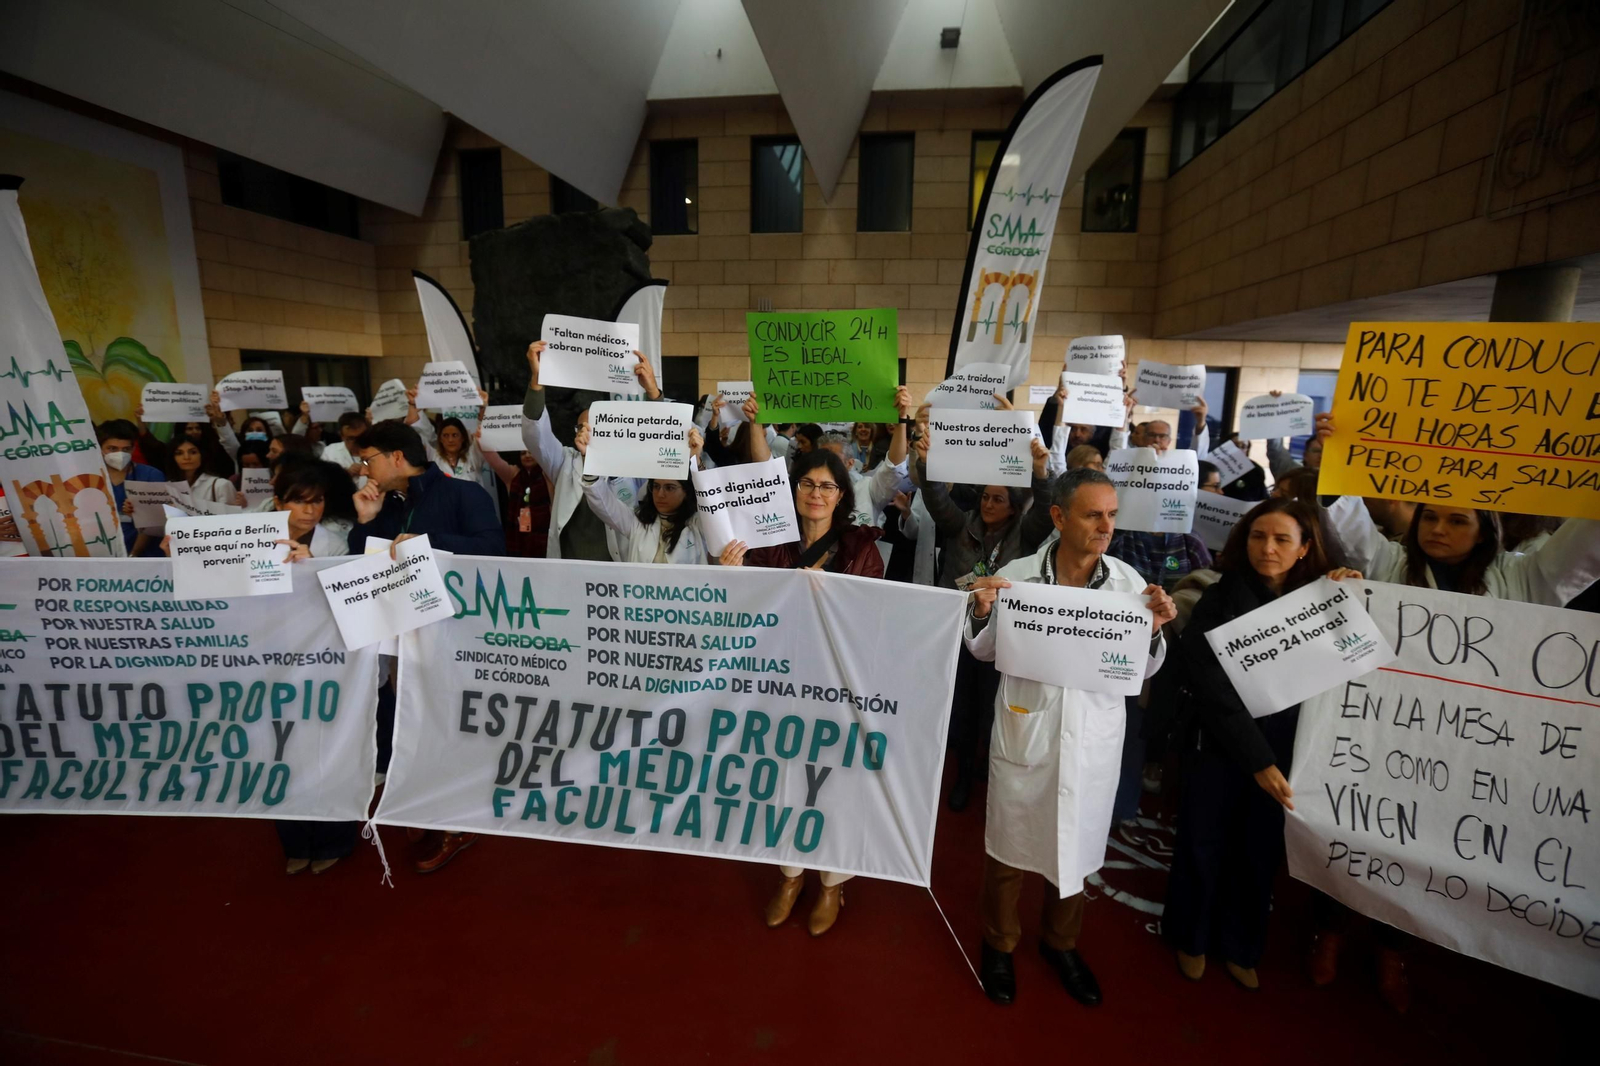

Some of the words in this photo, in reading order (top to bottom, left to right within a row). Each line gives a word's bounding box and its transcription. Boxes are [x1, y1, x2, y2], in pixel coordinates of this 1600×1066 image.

[987, 212, 1045, 244] SMA
[987, 242, 1040, 256] CÓRDOBA
[549, 328, 584, 340] “Faltan
[587, 334, 629, 346] médicos,
[850, 316, 873, 340] 24
[549, 342, 582, 353] sobran
[585, 347, 630, 359] políticos”
[763, 346, 789, 362] ES
[1356, 331, 1424, 368] PARA
[609, 364, 630, 374] SMA
[768, 368, 851, 387] ATENDER
[1141, 369, 1167, 379] ¡Mónica
[968, 374, 1005, 384] traidora!
[957, 384, 968, 392] 24
[970, 386, 996, 396] horas!
[1349, 371, 1388, 402] NO
[1402, 378, 1441, 408] TE
[1451, 382, 1572, 416] DEJAN
[764, 392, 842, 410] PACIENTES
[595, 414, 634, 425] ¡Mónica
[637, 416, 682, 427] petarda,
[930, 421, 980, 432] “Nuestros
[983, 423, 1031, 434] derechos
[1357, 408, 1397, 439] 24
[1415, 417, 1519, 449] HORAS
[593, 428, 610, 437] haz
[614, 429, 623, 437] tú
[627, 429, 636, 438] la
[639, 431, 684, 441] guardia!
[966, 438, 976, 446] tu
[979, 438, 1014, 447] salud”
[4, 440, 97, 460] CÓRDOBA
[659, 447, 681, 457] SMA
[1000, 455, 1024, 465] SMA
[1346, 445, 1422, 473] PERO
[1438, 456, 1498, 480] PARA
[1137, 464, 1194, 476] quemado,
[725, 475, 785, 493] dignidad,
[1130, 478, 1196, 492] colapsado”
[1369, 473, 1452, 498] VIDAS
[1162, 499, 1185, 509] SMA
[1196, 501, 1229, 516] “Menos
[754, 513, 784, 524] SMA
[1200, 514, 1220, 524] más
[171, 530, 190, 539] “De
[193, 528, 231, 539] España
[245, 524, 279, 534] Berlín,
[177, 544, 211, 556] porque
[214, 541, 237, 552] aquí
[258, 538, 278, 549] hay
[203, 554, 251, 568] porvenir”
[251, 560, 279, 570] SMA
[326, 576, 370, 592] “Menos
[372, 554, 430, 578] explotación,
[38, 578, 72, 591] POR
[76, 576, 174, 593] FORMACIÓN
[344, 590, 369, 605] más
[371, 568, 421, 598] protección”
[585, 583, 619, 598] POR
[623, 584, 727, 603] FORMACIÓN
[410, 588, 435, 602] SMA
[444, 567, 570, 630] SMA
[35, 599, 69, 612] POR
[73, 599, 228, 612] RESPONSABILIDAD
[1001, 598, 1053, 615] “Menos
[1058, 606, 1148, 626] explotación,
[41, 618, 78, 631] POR
[83, 618, 157, 631] NUESTRA
[161, 617, 215, 630] SALUD
[587, 605, 619, 620] POR
[624, 606, 778, 628] RESPONSABILIDAD
[1225, 624, 1286, 658] ¡Mónica,
[1285, 588, 1348, 626] traidora!
[587, 627, 620, 642] POR
[625, 629, 697, 648] NUESTRA
[700, 635, 757, 651] SALUD
[1014, 620, 1042, 631] más
[1047, 625, 1131, 641] protección”
[45, 637, 82, 650] POR
[85, 636, 172, 650] NUESTRAS
[175, 634, 248, 648] FAMILIAS
[1240, 648, 1278, 672] ¡Stop
[1280, 634, 1301, 652] 24
[1300, 611, 1348, 641] horas!
[1333, 633, 1366, 653] SMA
[50, 656, 85, 669] POR
[90, 656, 112, 669] LA
[115, 655, 197, 668] DIGNIDAD
[201, 654, 218, 667] DE
[222, 655, 260, 667] UNA
[262, 648, 345, 666] PROFESIÓN
[455, 650, 518, 666] SINDICATO
[521, 654, 567, 671] MÉDICO
[587, 649, 620, 664] POR
[624, 651, 703, 672] NUESTRAS
[709, 656, 790, 674] FAMILIAS
[1101, 651, 1135, 666] SMA
[475, 669, 489, 680] DE
[492, 668, 550, 687] CÓRDOBA
[187, 680, 340, 722] PROPIO
[587, 671, 619, 689] POR
[622, 674, 641, 690] LA
[645, 678, 727, 694] DIGNIDAD
[731, 678, 752, 693] DE
[758, 680, 796, 697] UNA
[801, 685, 898, 715] PROFESIÓN
[1341, 681, 1382, 721] EN
[1394, 694, 1424, 731] LA
[1437, 701, 1514, 746] MESA
[1540, 722, 1581, 759] DE
[0, 723, 76, 758] DEL
[92, 713, 248, 763] MÉDICO
[271, 721, 295, 761] Y
[460, 690, 686, 751] ESTATUTO
[707, 708, 888, 771] PROPIO
[494, 742, 574, 789] DEL
[599, 738, 778, 801] MÉDICO
[805, 764, 833, 806] Y
[1329, 737, 1370, 772] ES
[1386, 750, 1449, 792] COMO
[1472, 769, 1507, 804] EN
[1533, 782, 1591, 824] UNA
[0, 760, 290, 805] FACULTATIVO
[492, 785, 824, 853] FACULTATIVO
[1325, 782, 1417, 845] VIVEN
[1454, 814, 1507, 863] EN
[1535, 837, 1585, 889] EL
[1325, 840, 1404, 886] PERO
[1426, 866, 1467, 900] LO
